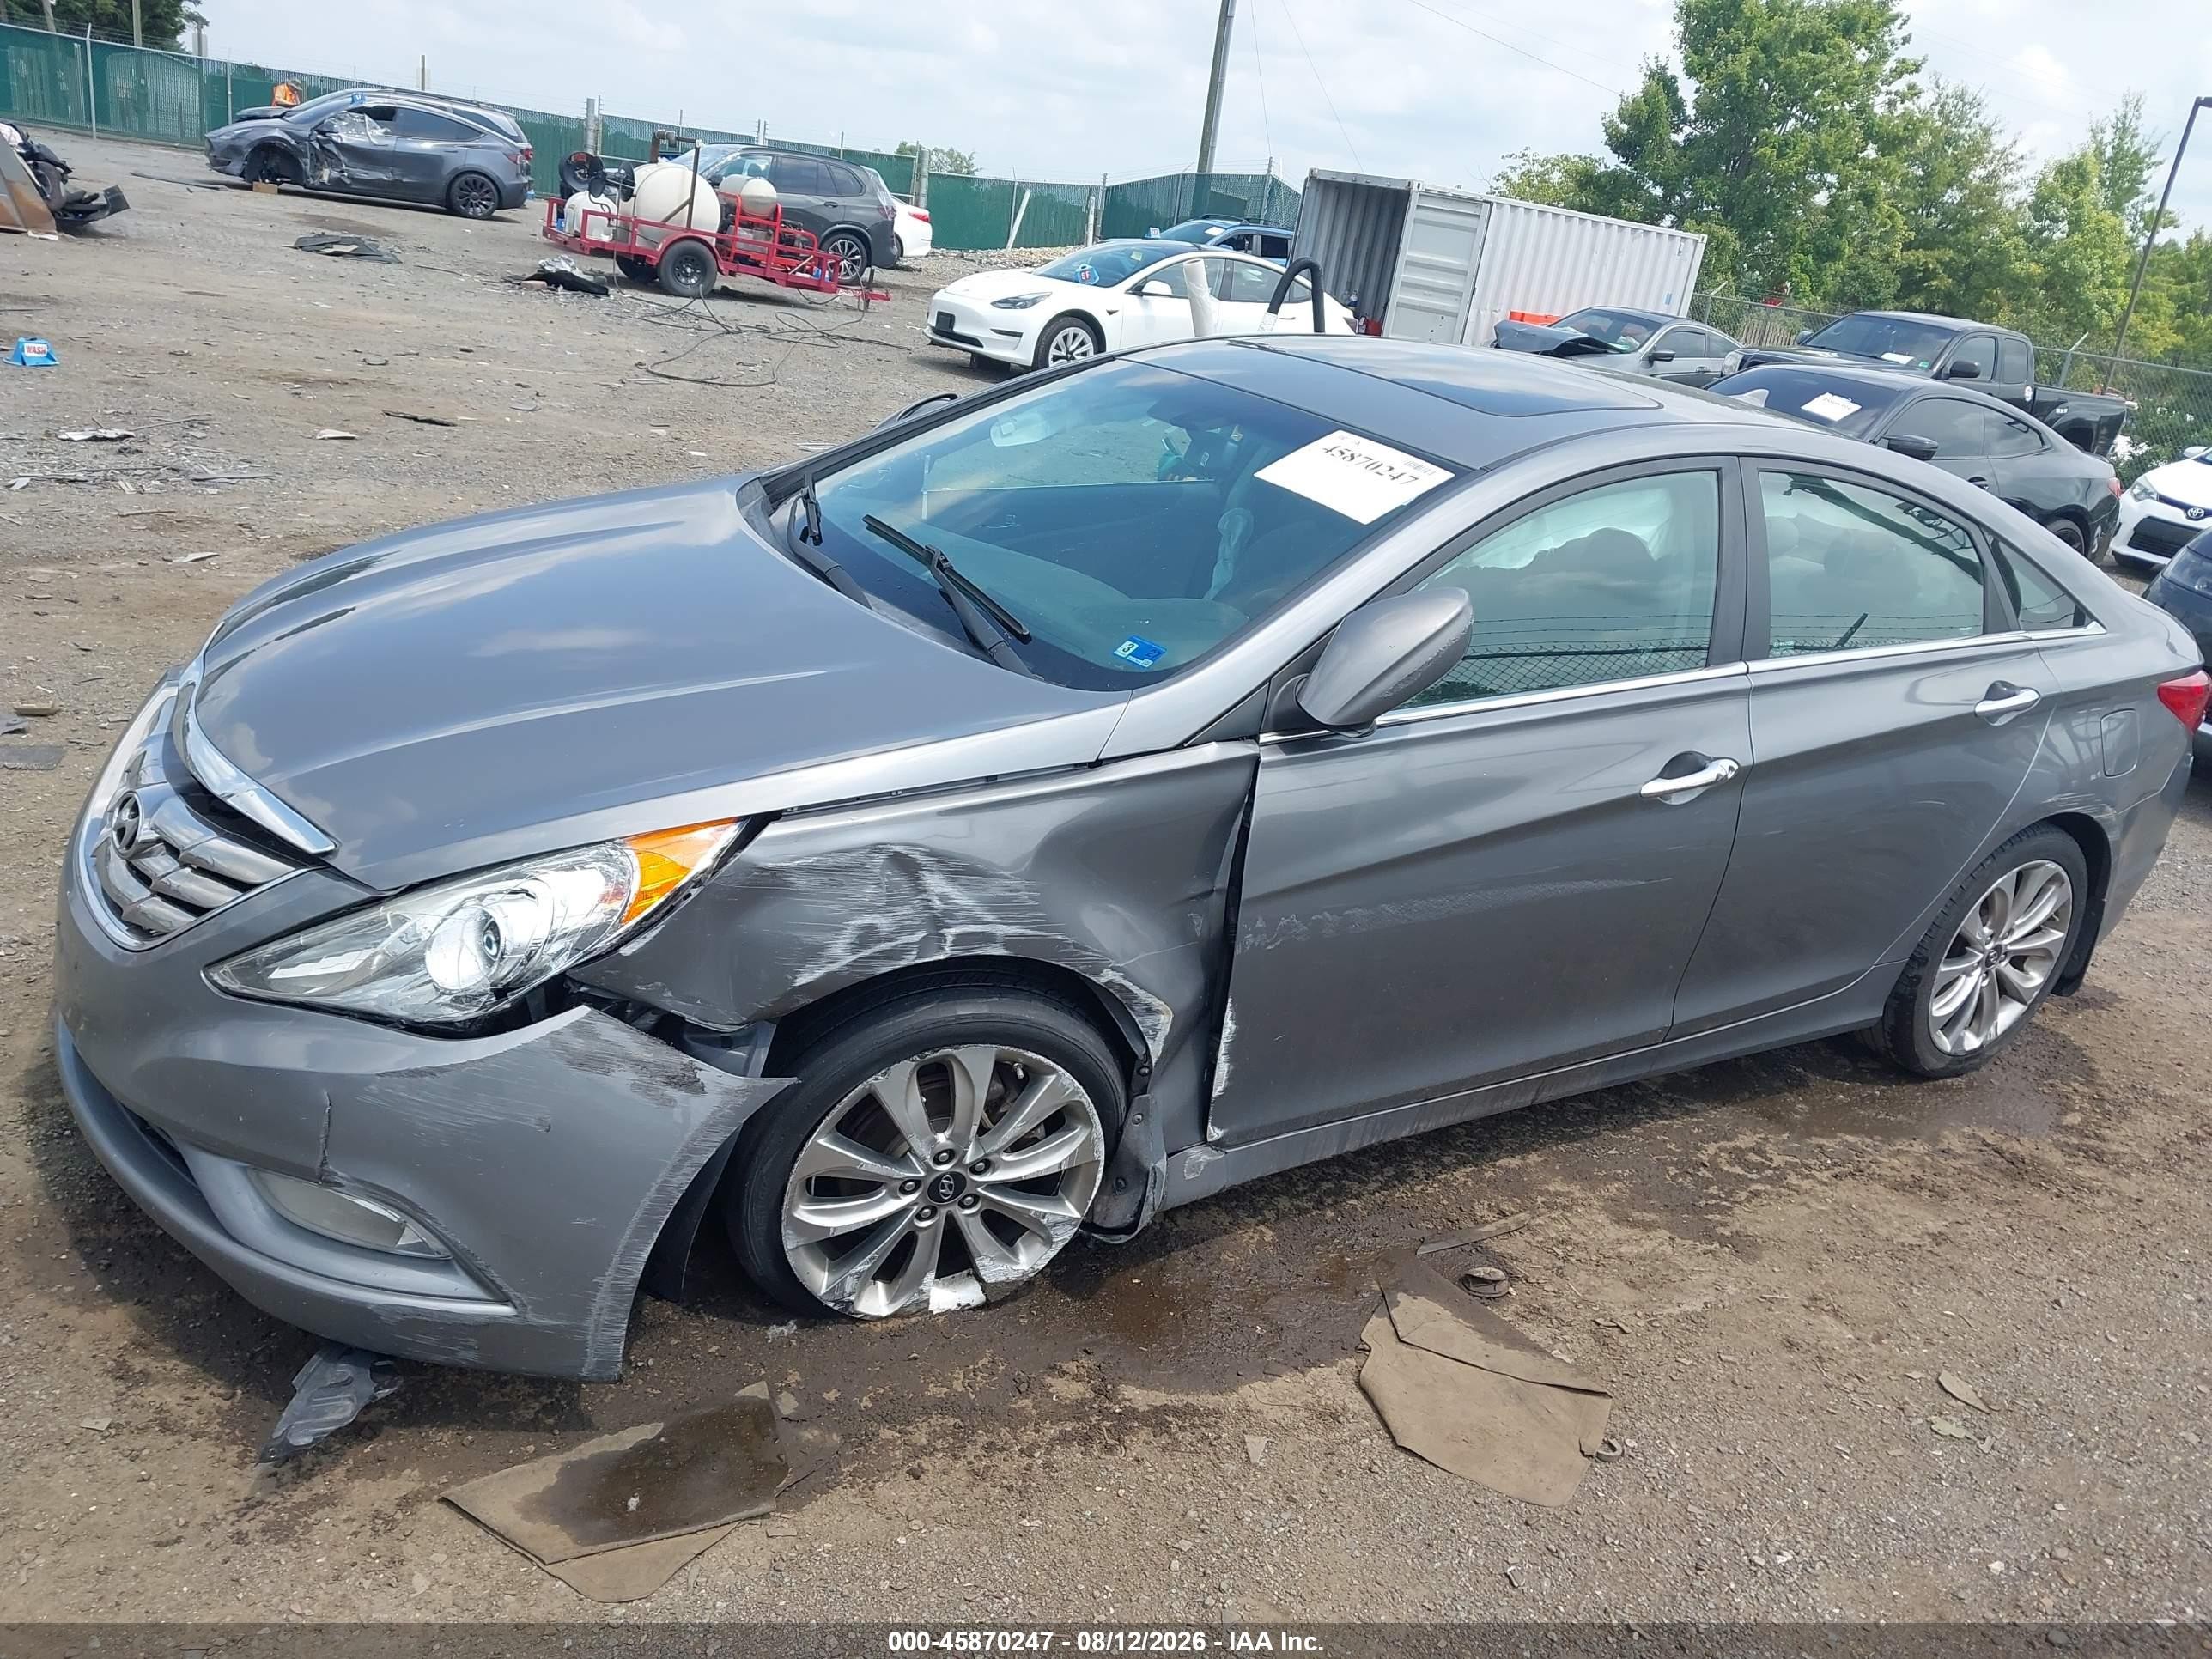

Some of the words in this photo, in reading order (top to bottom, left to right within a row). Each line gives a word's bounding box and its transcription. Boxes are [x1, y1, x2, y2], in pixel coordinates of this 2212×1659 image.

[26, 345, 46, 354] WASH
[1322, 445, 1419, 484] 45870247
[1122, 643, 1135, 653] 3
